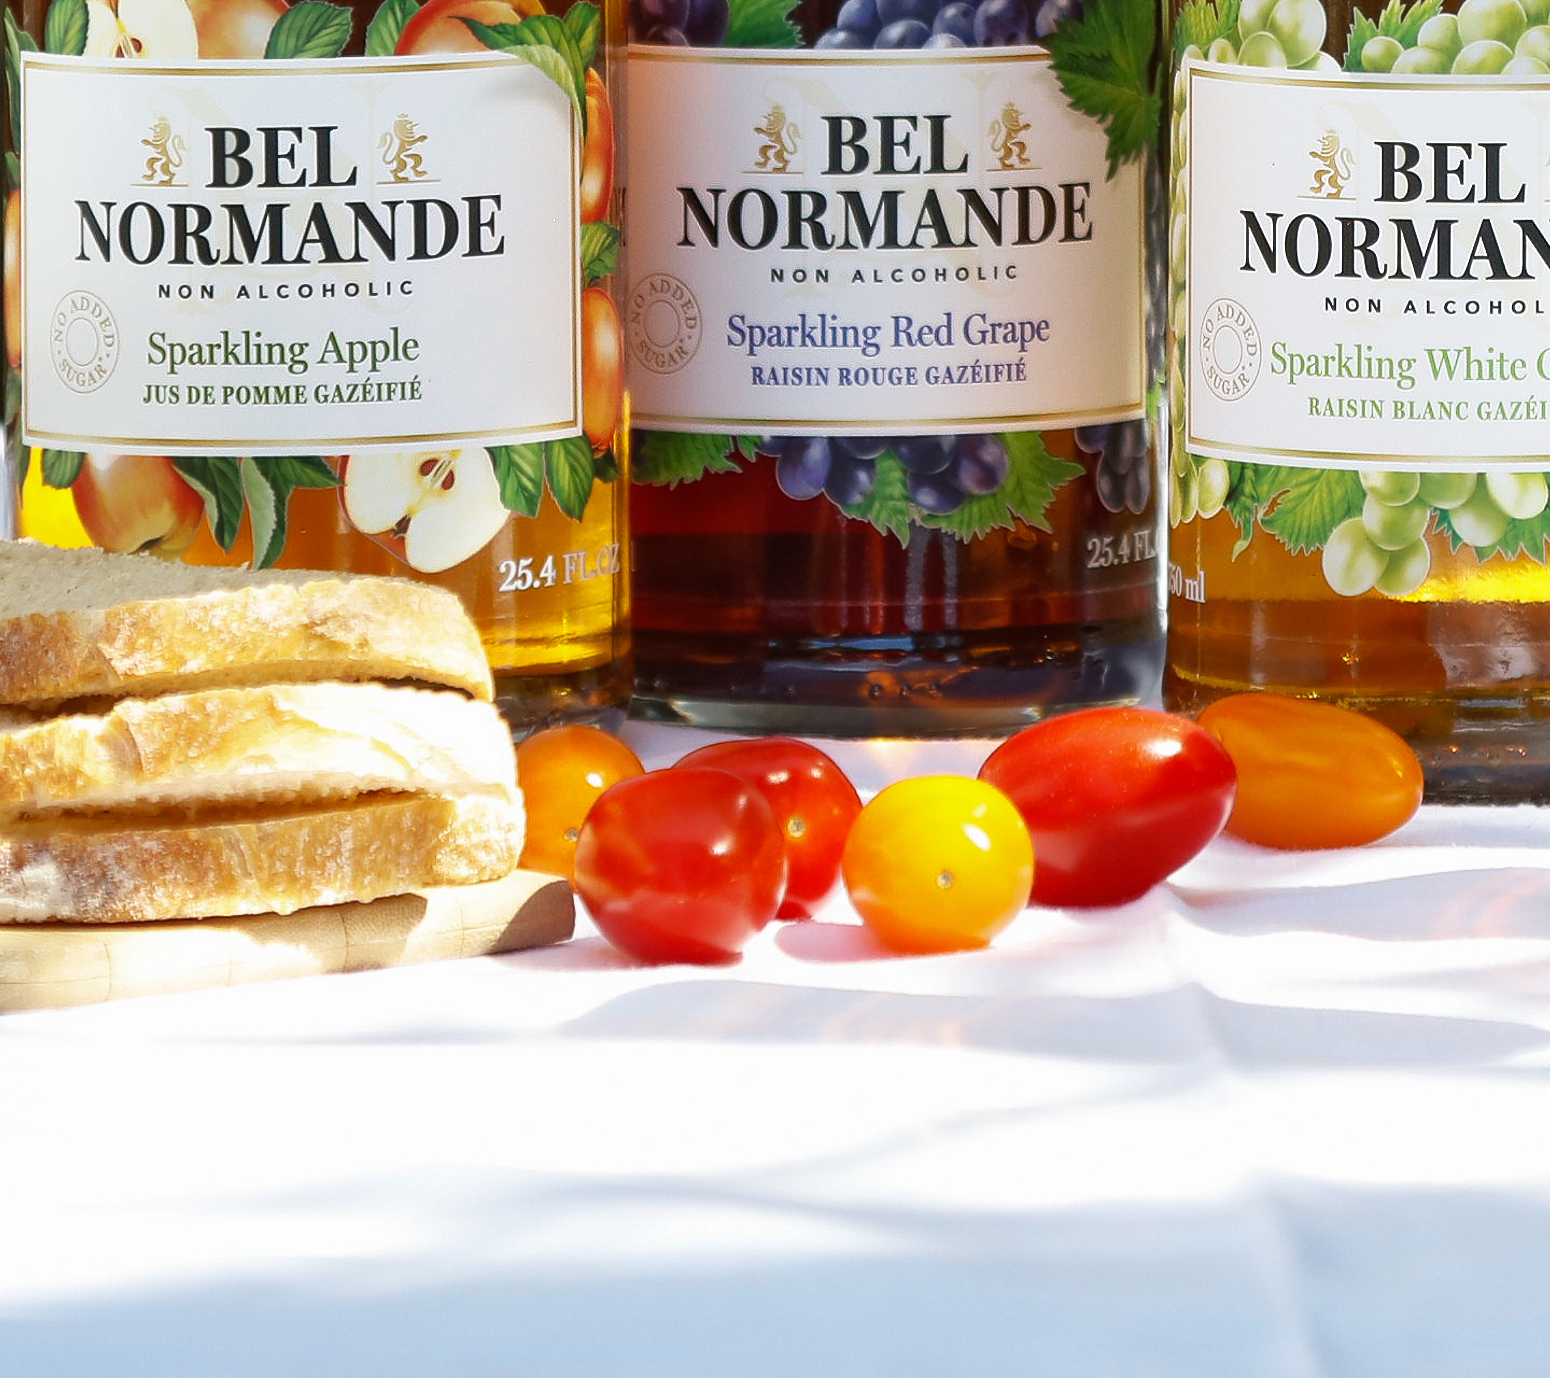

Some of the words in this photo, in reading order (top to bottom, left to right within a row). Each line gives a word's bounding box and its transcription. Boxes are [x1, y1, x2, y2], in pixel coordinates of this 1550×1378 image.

[204, 125, 358, 189] BEL
[820, 114, 969, 176] BEL
[1373, 141, 1526, 204] BEL
[74, 194, 505, 266] NORMANDE
[675, 181, 1095, 251] NORMANDE
[158, 284, 214, 301] NON
[236, 280, 414, 301] ALCOHOLIC
[770, 267, 829, 285] NON
[851, 264, 1018, 285] ALCOHOLIC
[53, 311, 68, 343] NO
[69, 296, 116, 348] ADDED
[630, 294, 646, 325] NO
[649, 278, 698, 331] ADDED
[1324, 296, 1382, 313] NON
[147, 330, 310, 375] Sparkling
[316, 326, 420, 373] Apple
[726, 313, 882, 358] Sparkling
[890, 311, 955, 349] Red
[963, 313, 1051, 353] Grape
[1202, 318, 1215, 351] NO
[1216, 304, 1258, 357] ADDED
[142, 384, 181, 405] JUS
[186, 385, 217, 406] DE
[221, 384, 308, 406] POMME
[313, 374, 423, 405] GAZÉIFIÉ
[750, 365, 831, 388] RAISIN
[837, 366, 919, 388] ROUGE
[925, 357, 1028, 386] GAZÉIFIÉ
[1270, 341, 1417, 391] Sparkling
[1423, 344, 1528, 382] White
[1308, 396, 1386, 420] RAISIN
[1392, 399, 1470, 422] BLANC
[498, 554, 558, 593] 25.4
[1086, 533, 1131, 569] 25.4
[1184, 569, 1207, 604] ml
